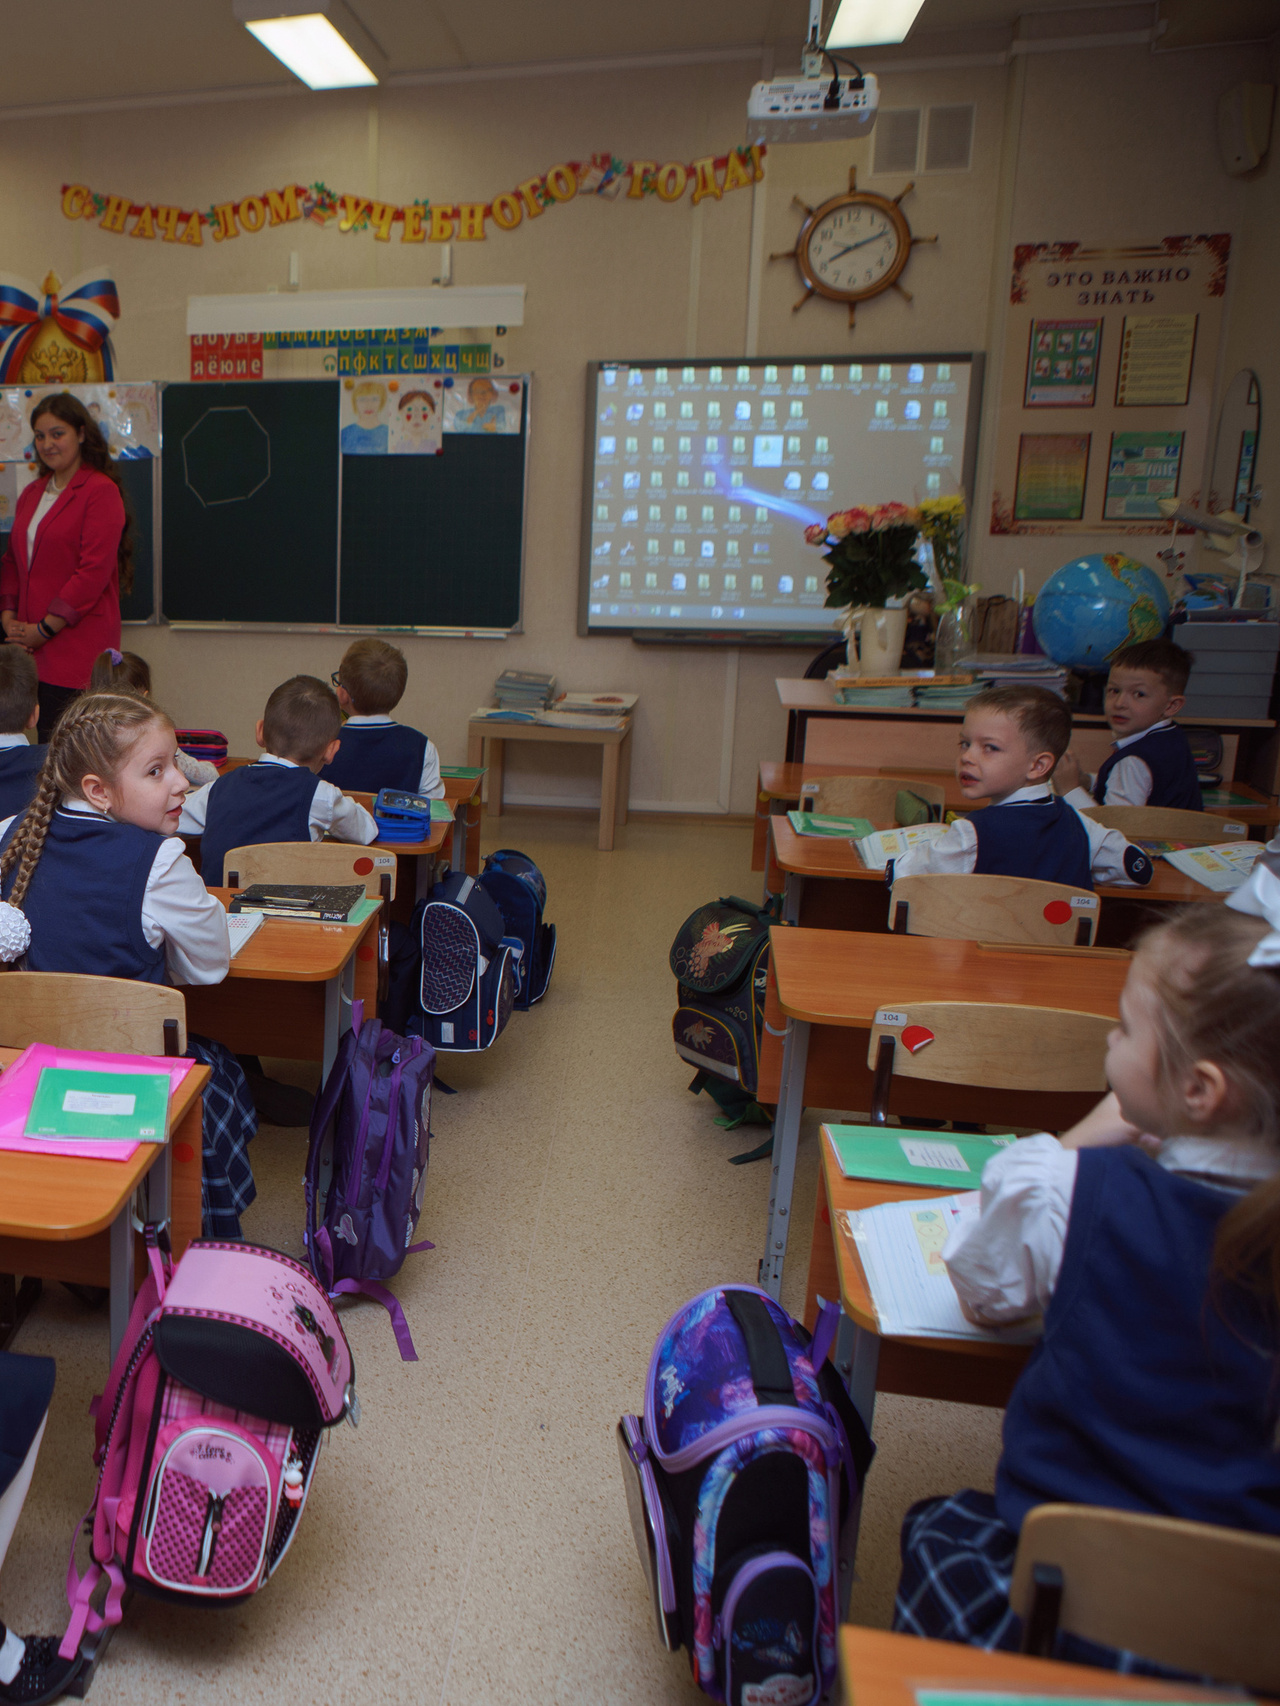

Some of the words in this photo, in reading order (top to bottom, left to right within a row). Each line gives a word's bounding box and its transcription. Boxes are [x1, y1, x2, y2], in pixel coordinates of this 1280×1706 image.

[61, 184, 88, 219] С
[99, 183, 302, 247] НАЧАЛОМ
[338, 163, 579, 242] УЧЕБНОГО
[626, 145, 764, 206] ГОДА!
[1047, 271, 1093, 287] ЭТО
[1101, 266, 1192, 285] ВАЖНО
[1077, 289, 1155, 305] ЗНАТЬ
